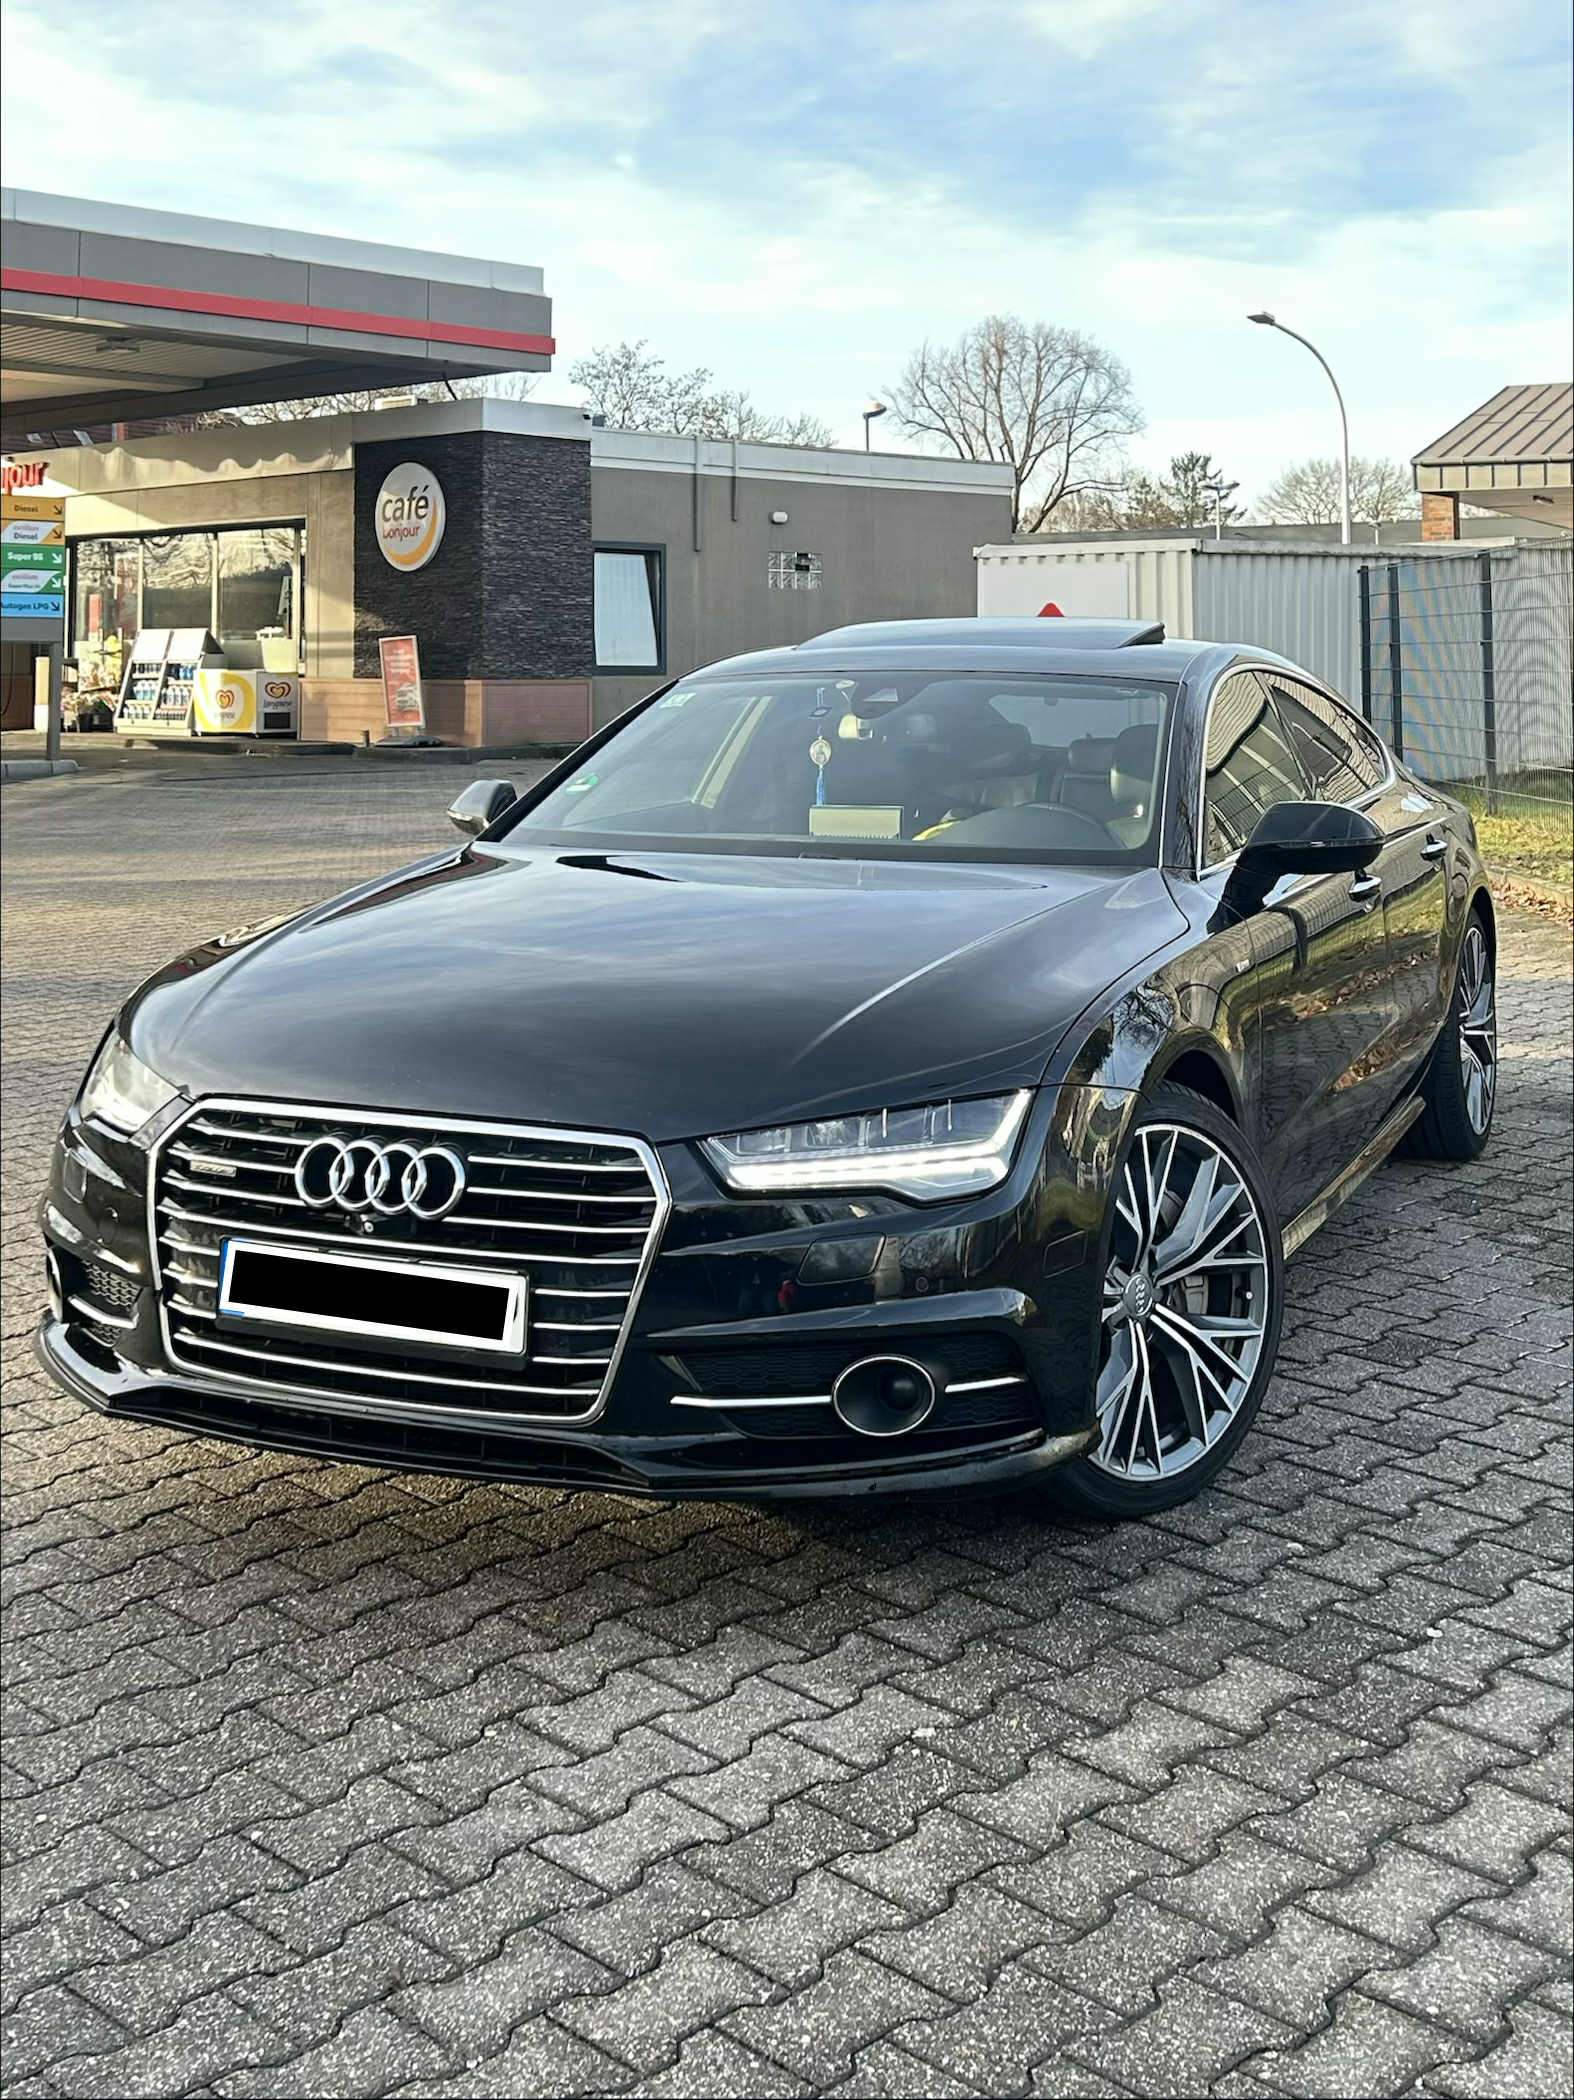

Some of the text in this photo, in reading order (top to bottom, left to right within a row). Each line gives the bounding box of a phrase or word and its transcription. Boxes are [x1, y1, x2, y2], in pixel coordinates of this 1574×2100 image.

[382, 485, 430, 522] café
[14, 504, 39, 513] Diesel
[13, 532, 38, 540] Diesel
[382, 524, 420, 541] bonjour
[8, 552, 31, 561] Super
